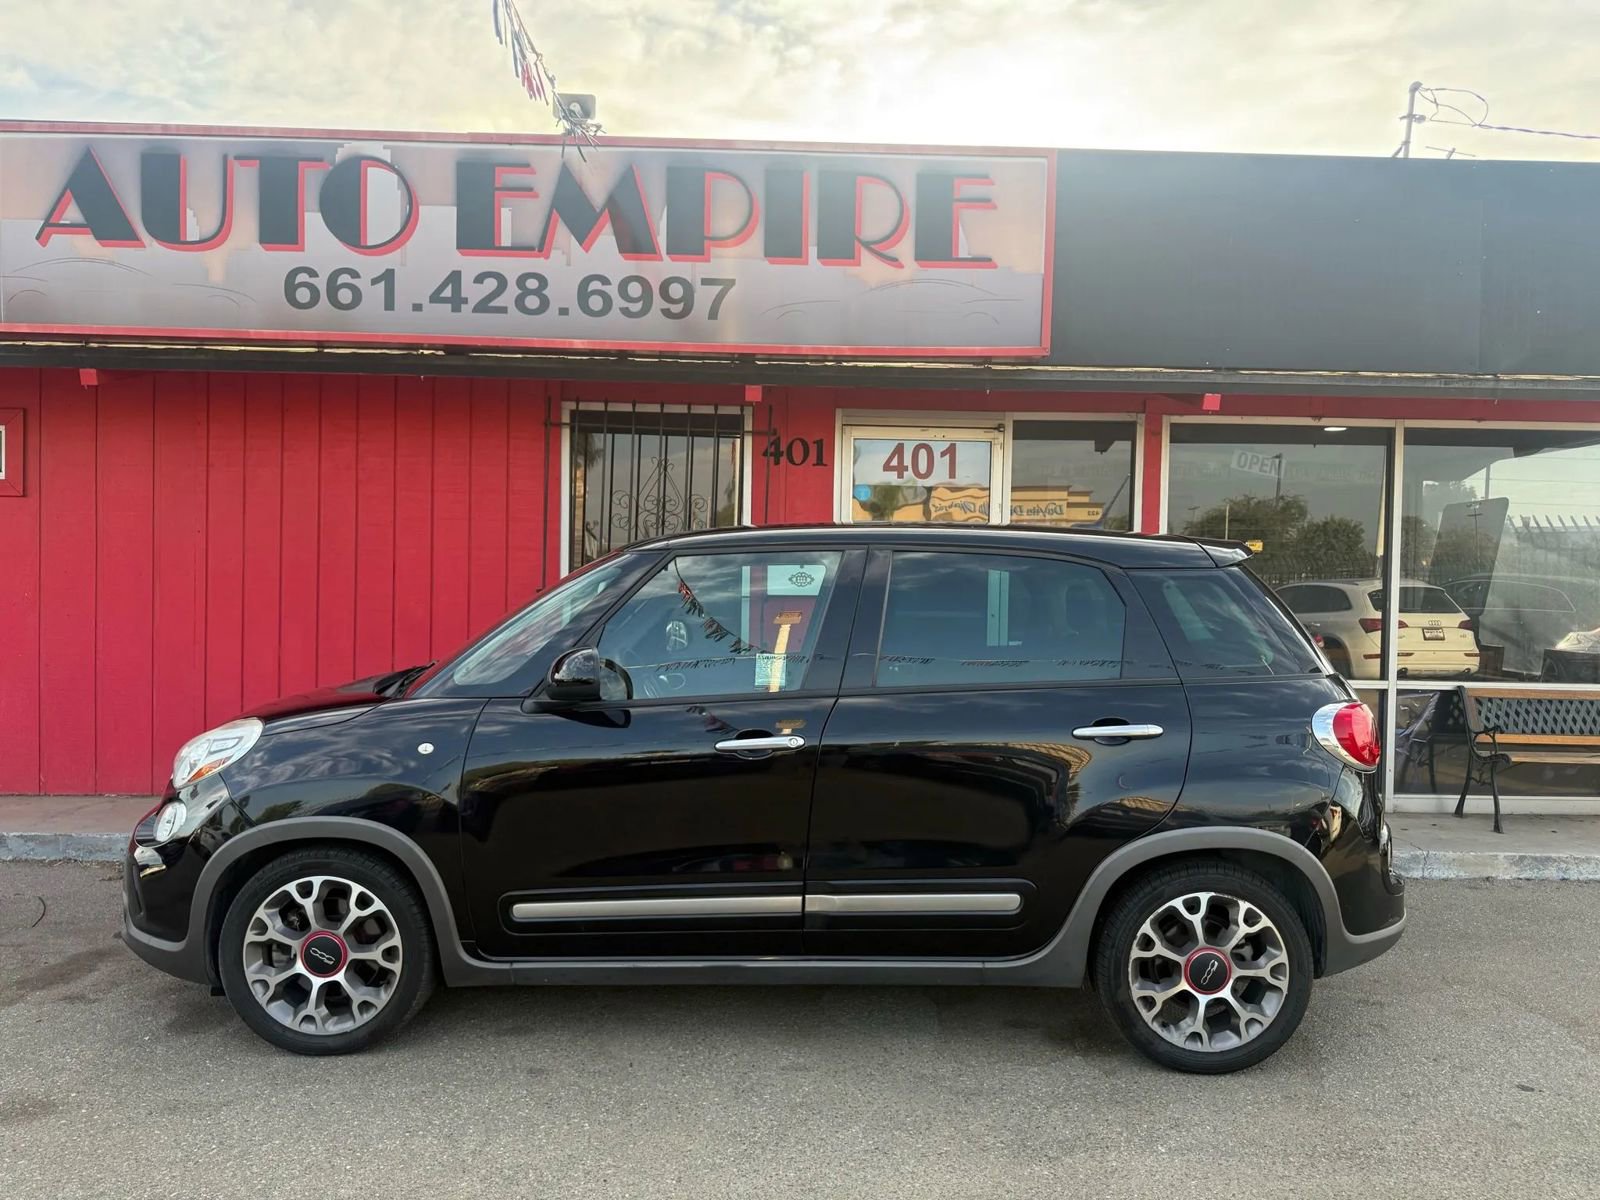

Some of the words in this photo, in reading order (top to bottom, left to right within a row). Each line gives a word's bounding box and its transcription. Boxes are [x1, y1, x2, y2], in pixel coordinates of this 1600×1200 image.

[35, 145, 420, 257] AUTO
[456, 156, 998, 269] EMPIRE
[283, 266, 737, 321] 661.428.6997
[762, 435, 828, 467] 401
[883, 442, 957, 480] 401
[1236, 451, 1282, 475] OPEN
